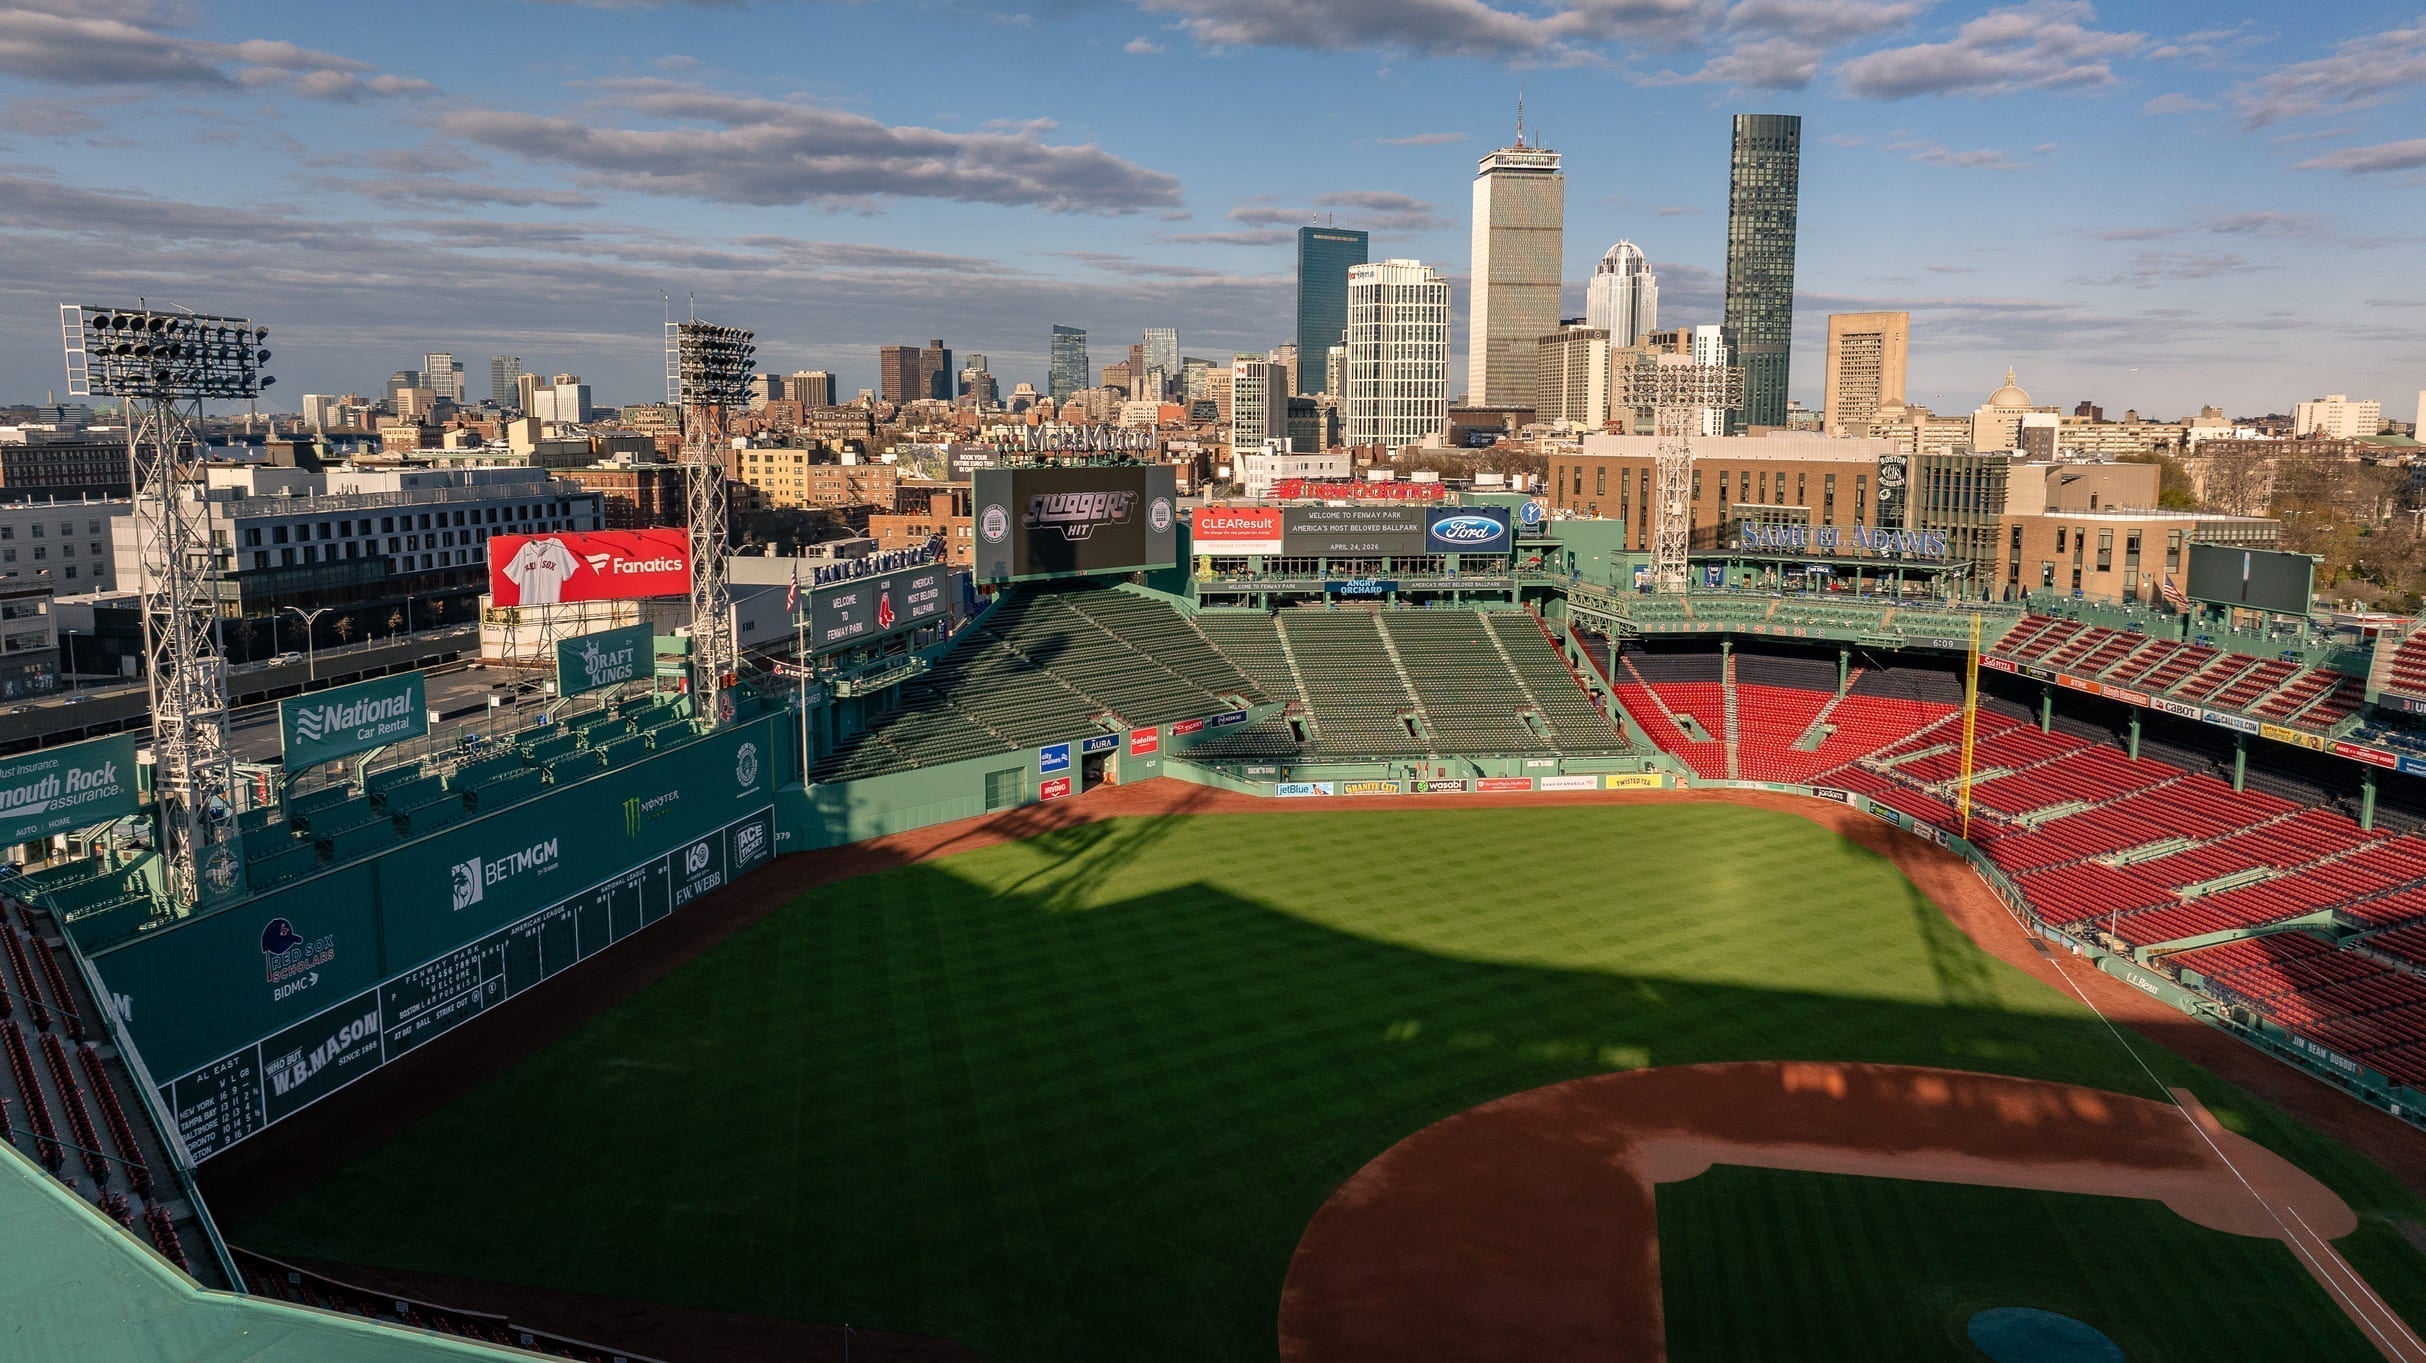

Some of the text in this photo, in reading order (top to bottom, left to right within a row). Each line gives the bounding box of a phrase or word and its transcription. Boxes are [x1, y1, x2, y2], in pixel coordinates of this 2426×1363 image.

[1024, 424, 1160, 452] MassMutual
[1880, 455, 1907, 466] BOSTON
[1201, 518, 1273, 529] CLEAResult
[1309, 511, 1401, 519] WELCOME TO FENWAY PARK
[1067, 525, 1090, 536] HIT
[1293, 524, 1418, 532] AMERICA'S MOST BELOVED BALLPARK
[1445, 519, 1489, 540] Ford
[1741, 522, 1947, 557] SAMUEL ADAMS
[542, 560, 556, 571] SOX
[613, 556, 683, 575] Fanatics
[813, 547, 927, 586] BANK OF AMERICA
[907, 588, 939, 604] MOST BELOVED
[1340, 586, 1383, 594] ORCHARD
[832, 594, 857, 609] WELCOME
[912, 602, 935, 617] BALLPARK
[841, 611, 849, 622] TO
[827, 622, 863, 640] FENWAY PARK
[1932, 639, 1954, 648] 6:09
[585, 648, 634, 676] DRAFT
[591, 664, 633, 687] KINGS
[357, 716, 410, 741] Car Rental
[1041, 752, 1052, 760] city
[1042, 757, 1061, 766] cruises
[1146, 760, 1156, 768] 420
[16, 759, 60, 775] Insurance.
[65, 761, 117, 794] Rock
[1345, 782, 1399, 793] GRANITE CITY
[1428, 781, 1462, 789] wasabi
[1617, 778, 1641, 787] TWISTED
[49, 784, 120, 811] assurance
[1044, 783, 1066, 795] IRVING
[1280, 784, 1309, 795] jetBlue
[641, 790, 680, 813] MONSTER
[15, 817, 71, 838] AUTO HOME
[740, 825, 763, 849] ACE
[775, 832, 791, 841] 379
[741, 836, 764, 858] TICKET
[485, 837, 559, 887] BETMGM
[694, 871, 721, 895] WEBB
[272, 934, 335, 971] RED SOX
[272, 949, 335, 984] SCHOLARS
[405, 945, 480, 985] FENWAY PARK
[274, 977, 309, 1001] BIDMC
[416, 1016, 431, 1030] BALL
[436, 1004, 455, 1020] STRIKE
[456, 997, 468, 1009] OUT
[265, 1049, 303, 1076] WHO BUY
[338, 1049, 361, 1066] SINCE
[2293, 1035, 2358, 1074] JIM BEAM DUGOUT
[196, 1057, 240, 1084] AL EAST
[180, 1106, 195, 1121] NEW
[196, 1097, 215, 1111] YORK
[180, 1115, 203, 1132] TAMPA
[203, 1107, 218, 1120] BAY
